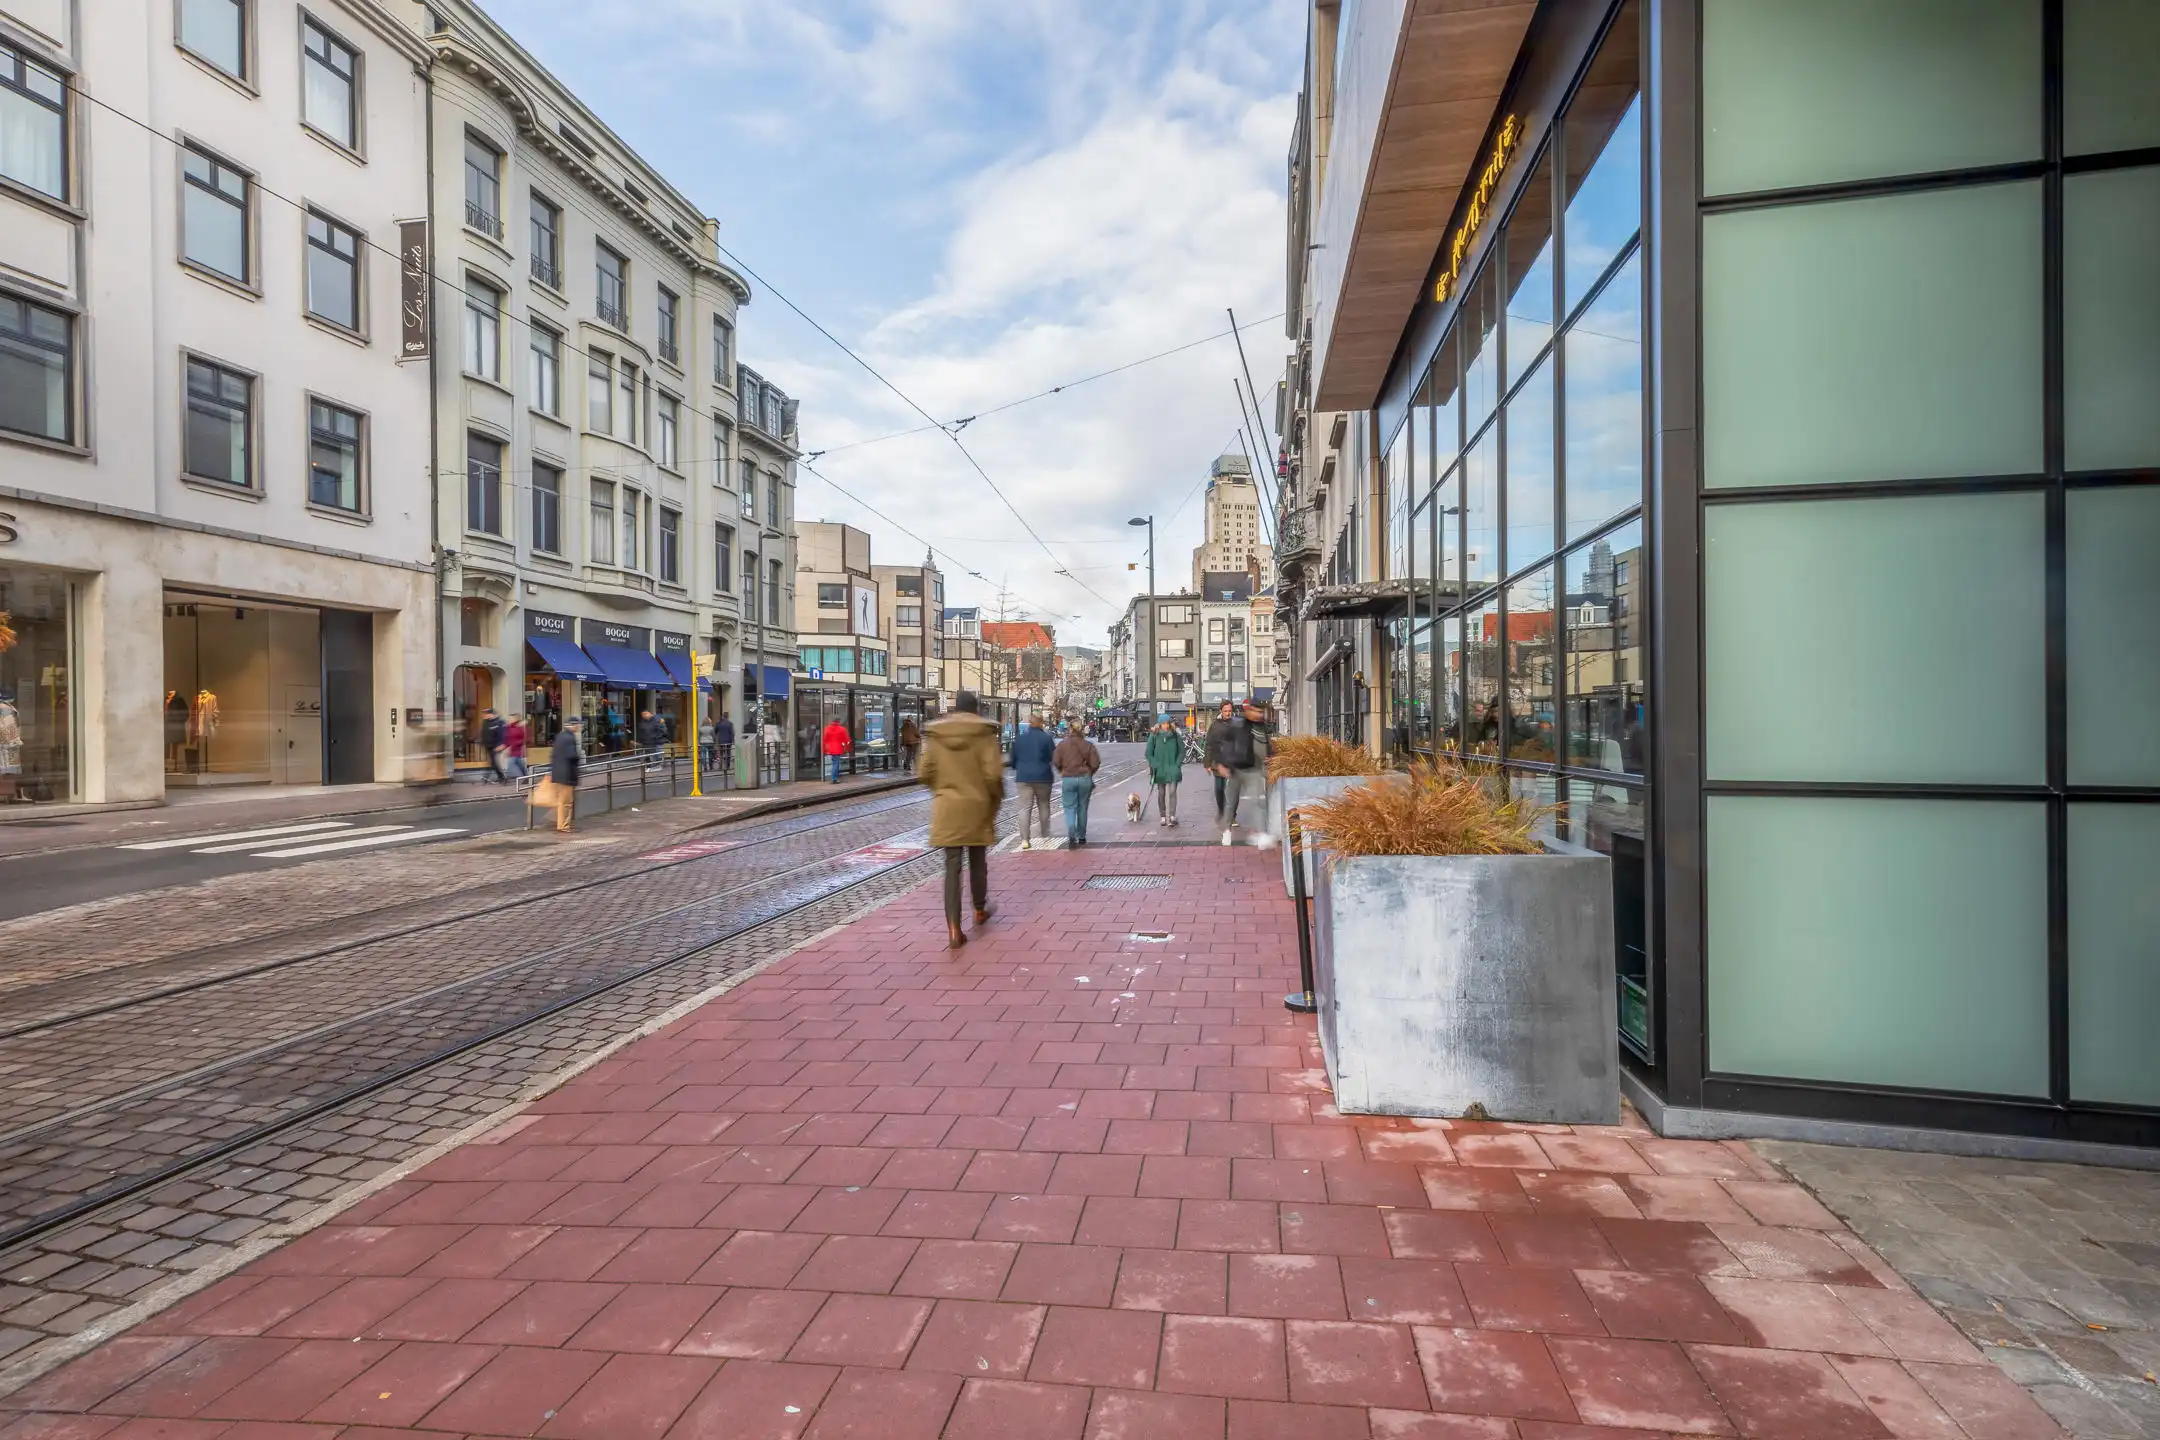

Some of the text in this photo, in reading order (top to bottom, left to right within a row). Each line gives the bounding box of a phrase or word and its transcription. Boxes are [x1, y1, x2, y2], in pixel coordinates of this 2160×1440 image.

[403, 245, 424, 333] Les Nuits
[535, 616, 564, 629] BOGGI
[605, 627, 630, 638] BOGGI
[663, 636, 684, 646] BOGGI
